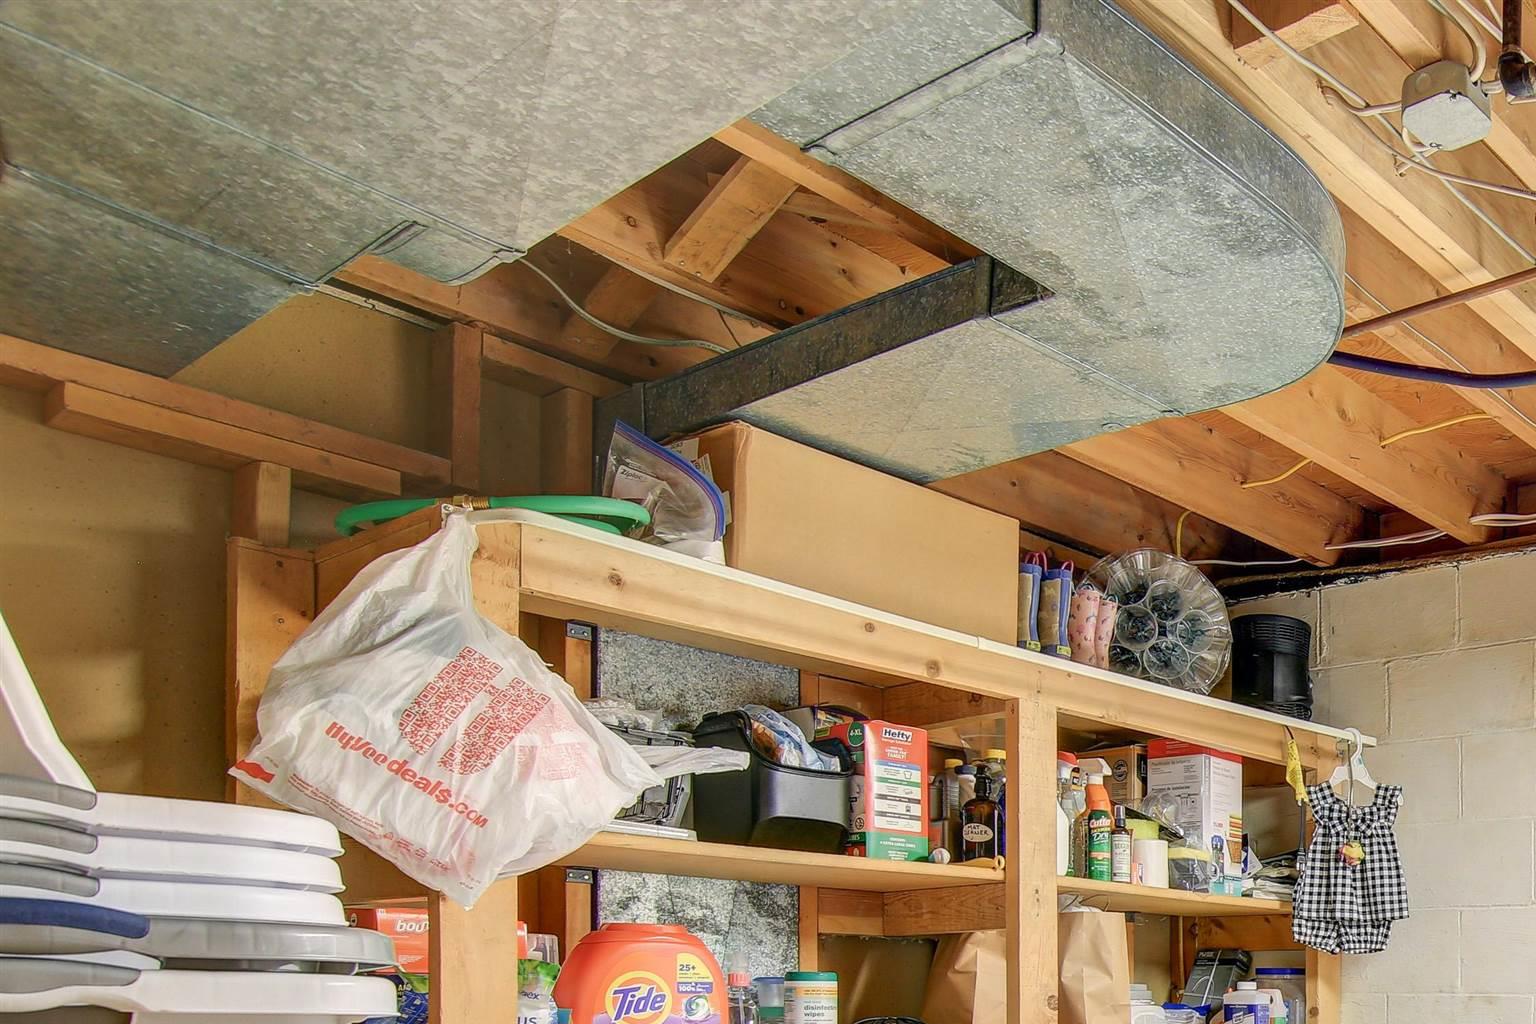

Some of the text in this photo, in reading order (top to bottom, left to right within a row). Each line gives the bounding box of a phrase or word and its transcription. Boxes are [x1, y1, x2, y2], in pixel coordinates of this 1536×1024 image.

[883, 728, 911, 741] Hefty
[679, 964, 696, 972] 25+
[611, 983, 667, 1023] Tide
